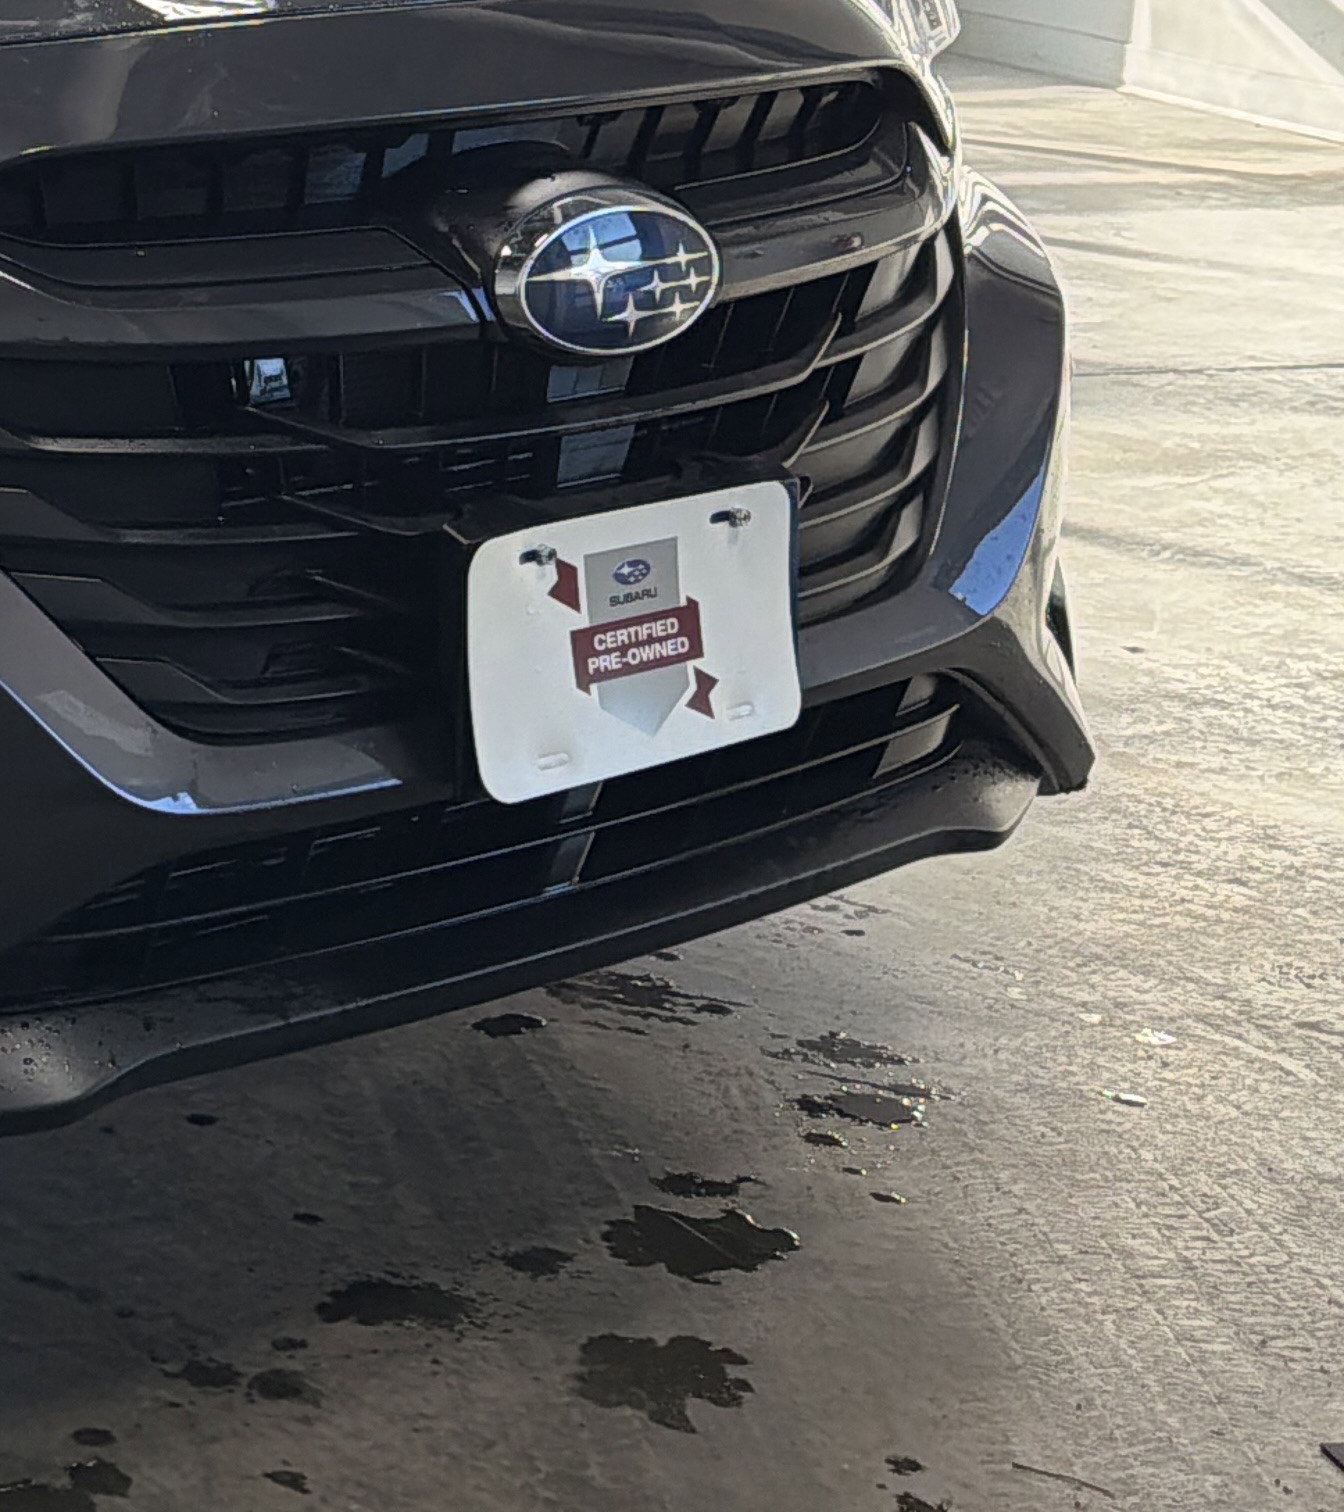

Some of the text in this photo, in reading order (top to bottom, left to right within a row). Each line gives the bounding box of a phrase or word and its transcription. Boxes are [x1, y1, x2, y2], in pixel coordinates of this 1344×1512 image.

[609, 586, 658, 607] SUBARU
[593, 617, 680, 651] CERTIFIED
[587, 636, 690, 676] PRE-OWNED
